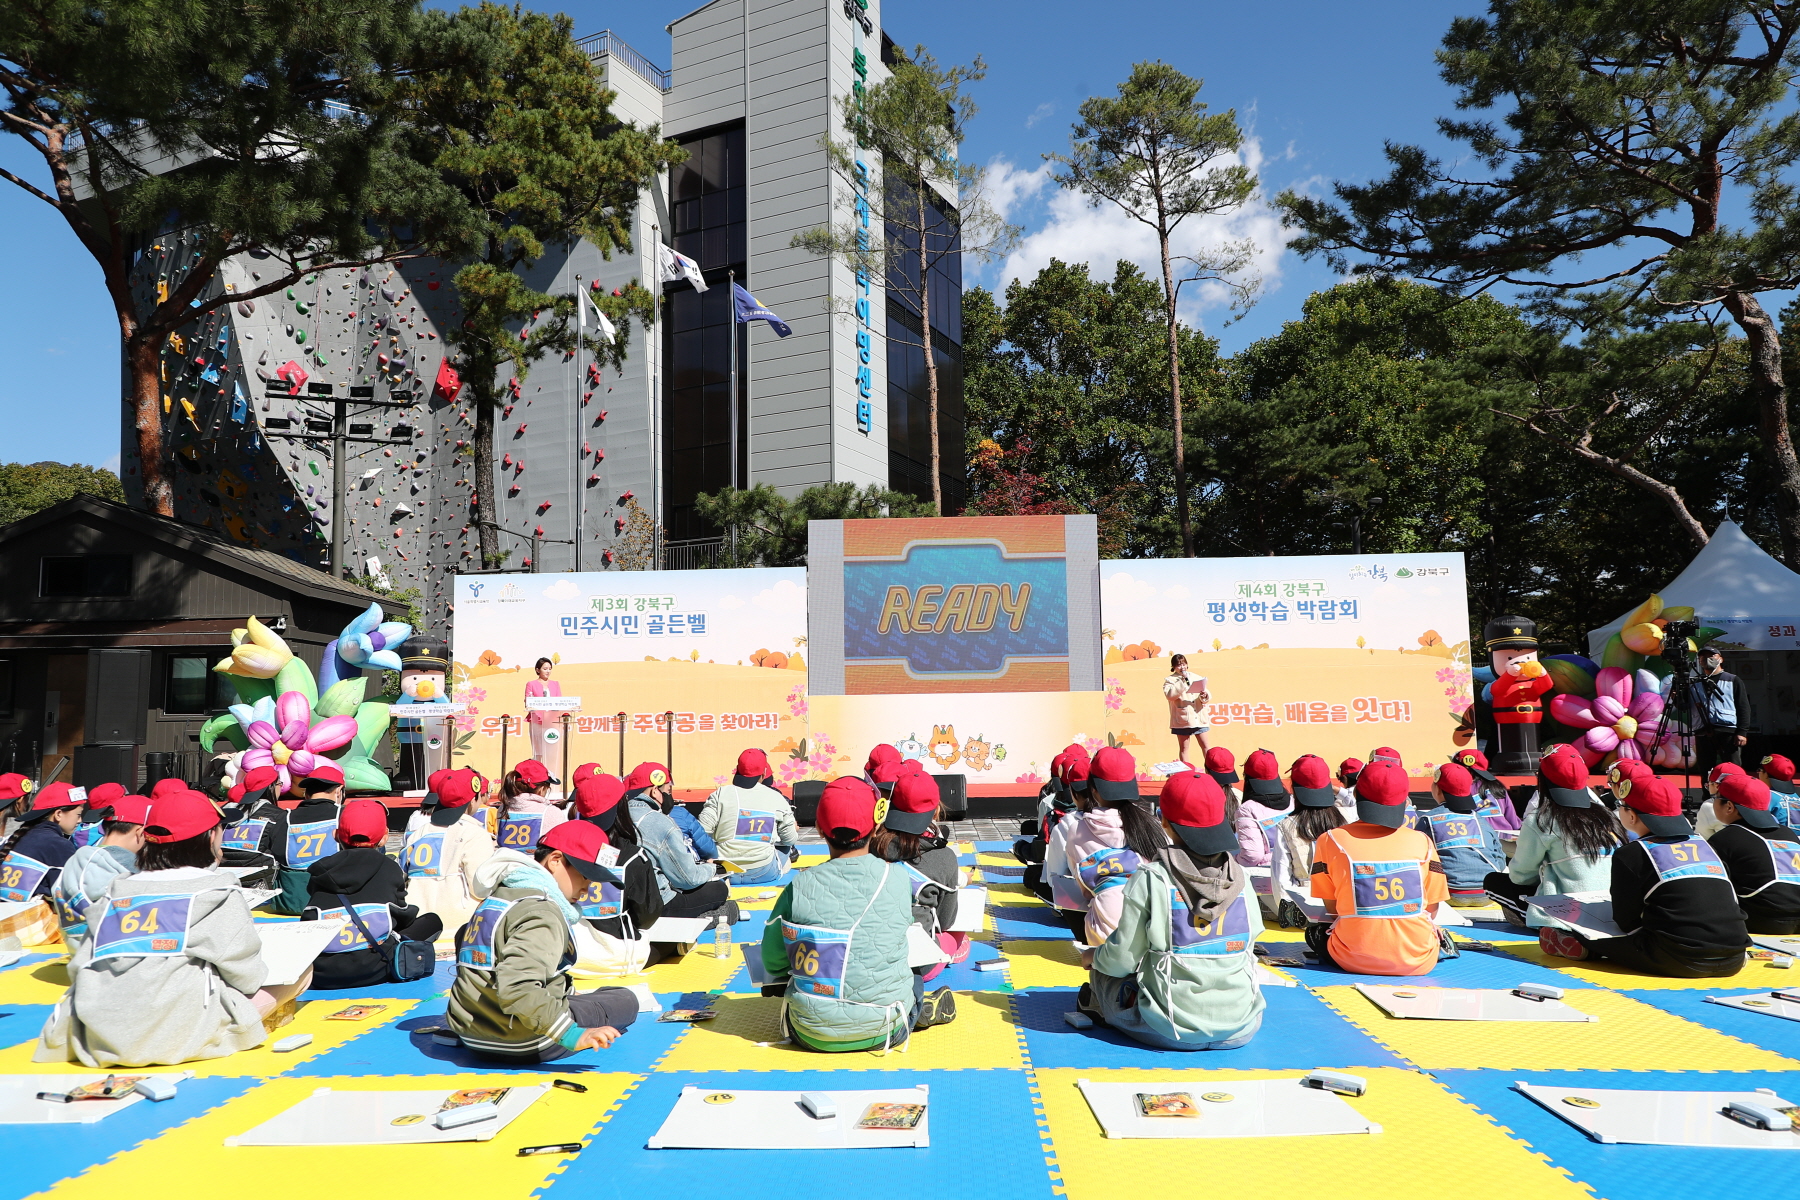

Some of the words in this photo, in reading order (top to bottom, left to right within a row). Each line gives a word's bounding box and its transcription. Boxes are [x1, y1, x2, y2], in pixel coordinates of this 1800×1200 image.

[1416, 567, 1449, 577] 강북구
[1237, 583, 1278, 598] 제4회
[1282, 582, 1325, 598] 강북구
[591, 598, 628, 612] 제3회
[634, 597, 675, 612] 강북구
[877, 582, 1032, 635] READY
[1206, 600, 1290, 623] 평생학습
[1296, 599, 1359, 621] 박람회
[560, 615, 639, 636] 민주시민
[646, 613, 706, 635] 골든벨
[720, 713, 779, 730] 찾아라!
[1207, 703, 1281, 726] 생학습,
[1284, 702, 1349, 723] 배움을
[1352, 697, 1412, 723] 잇다!
[233, 826, 250, 840] 14
[504, 824, 530, 846] 28
[749, 819, 765, 832] 17
[1445, 822, 1468, 836] 33
[296, 833, 327, 858] 27
[1670, 843, 1700, 862] 57
[0, 866, 23, 888] 38
[1374, 877, 1405, 901] 56
[120, 907, 159, 934] 64
[339, 920, 370, 946] 52
[795, 943, 820, 976] 66
[708, 1093, 733, 1102] 78
